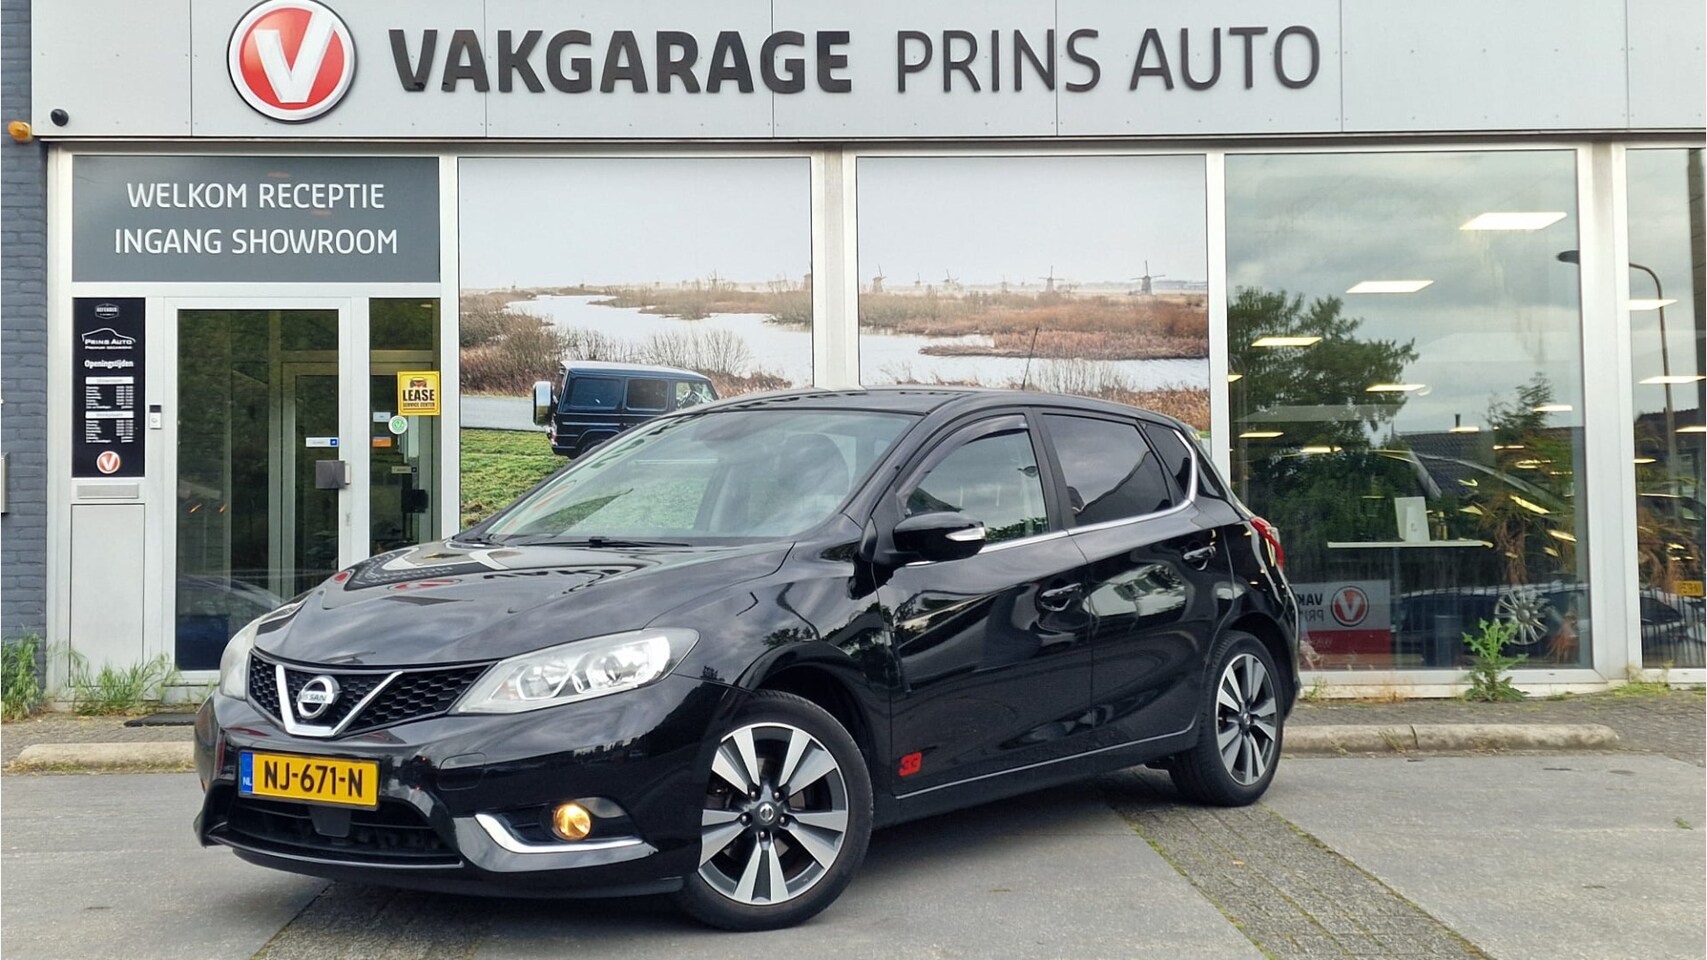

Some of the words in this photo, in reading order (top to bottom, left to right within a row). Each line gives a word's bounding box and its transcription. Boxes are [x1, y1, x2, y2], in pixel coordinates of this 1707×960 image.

[388, 29, 852, 94] VAKGARAGE
[897, 28, 1101, 93] PRINS
[1129, 25, 1321, 91] AUTO
[127, 183, 247, 208] WELKOM
[259, 183, 385, 209] RECEPTIE
[115, 228, 222, 254] INGANG
[231, 228, 398, 254] SHOWROOM
[84, 359, 134, 369] Openingstijden
[402, 389, 435, 402] LEASE
[264, 760, 363, 798] NJ-671-N
